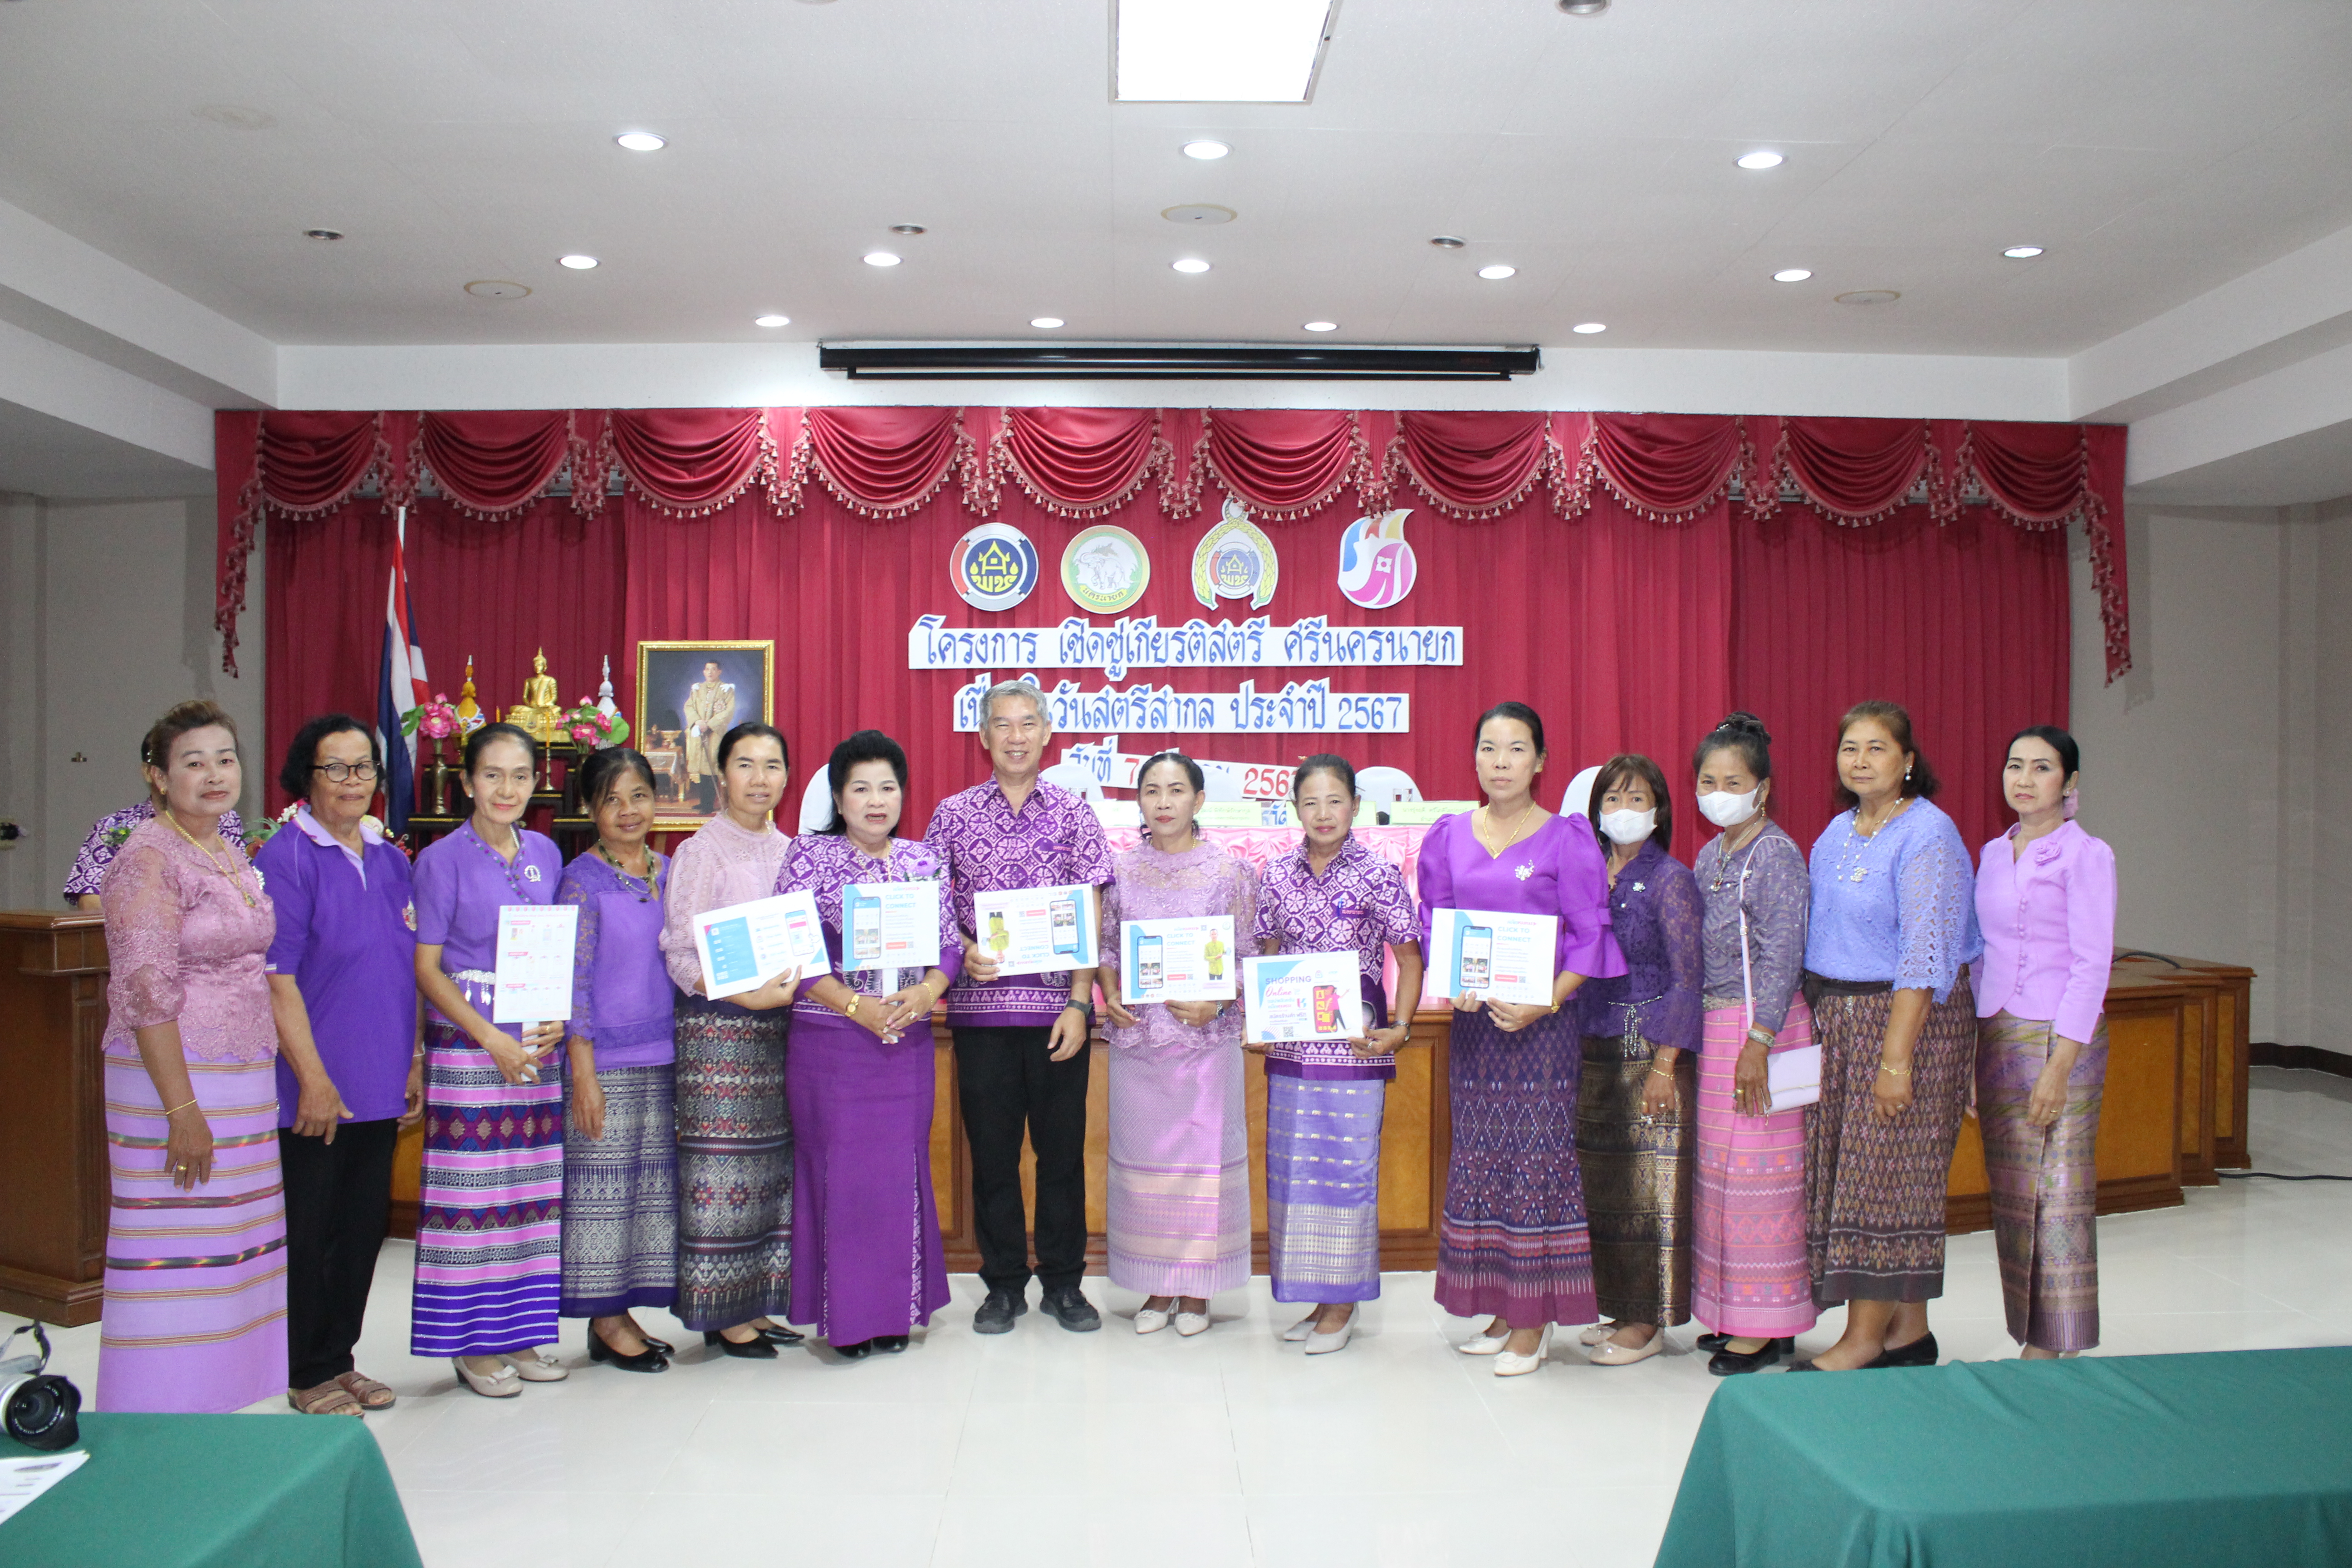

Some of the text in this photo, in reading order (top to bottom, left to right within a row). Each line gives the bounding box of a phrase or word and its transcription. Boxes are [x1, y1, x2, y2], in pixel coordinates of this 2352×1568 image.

[1083, 588, 1124, 602] นครนายก
[918, 615, 1455, 677] โครงการ เชิดชูเกียรติสตรี ศรีนครนายก
[1230, 682, 1326, 730] ประจำปี
[1338, 696, 1402, 730] 2567
[1125, 758, 1140, 786] 7
[1244, 767, 1297, 797] 256
[1265, 975, 1312, 985] SHOPPING
[1265, 986, 1292, 997] Online
